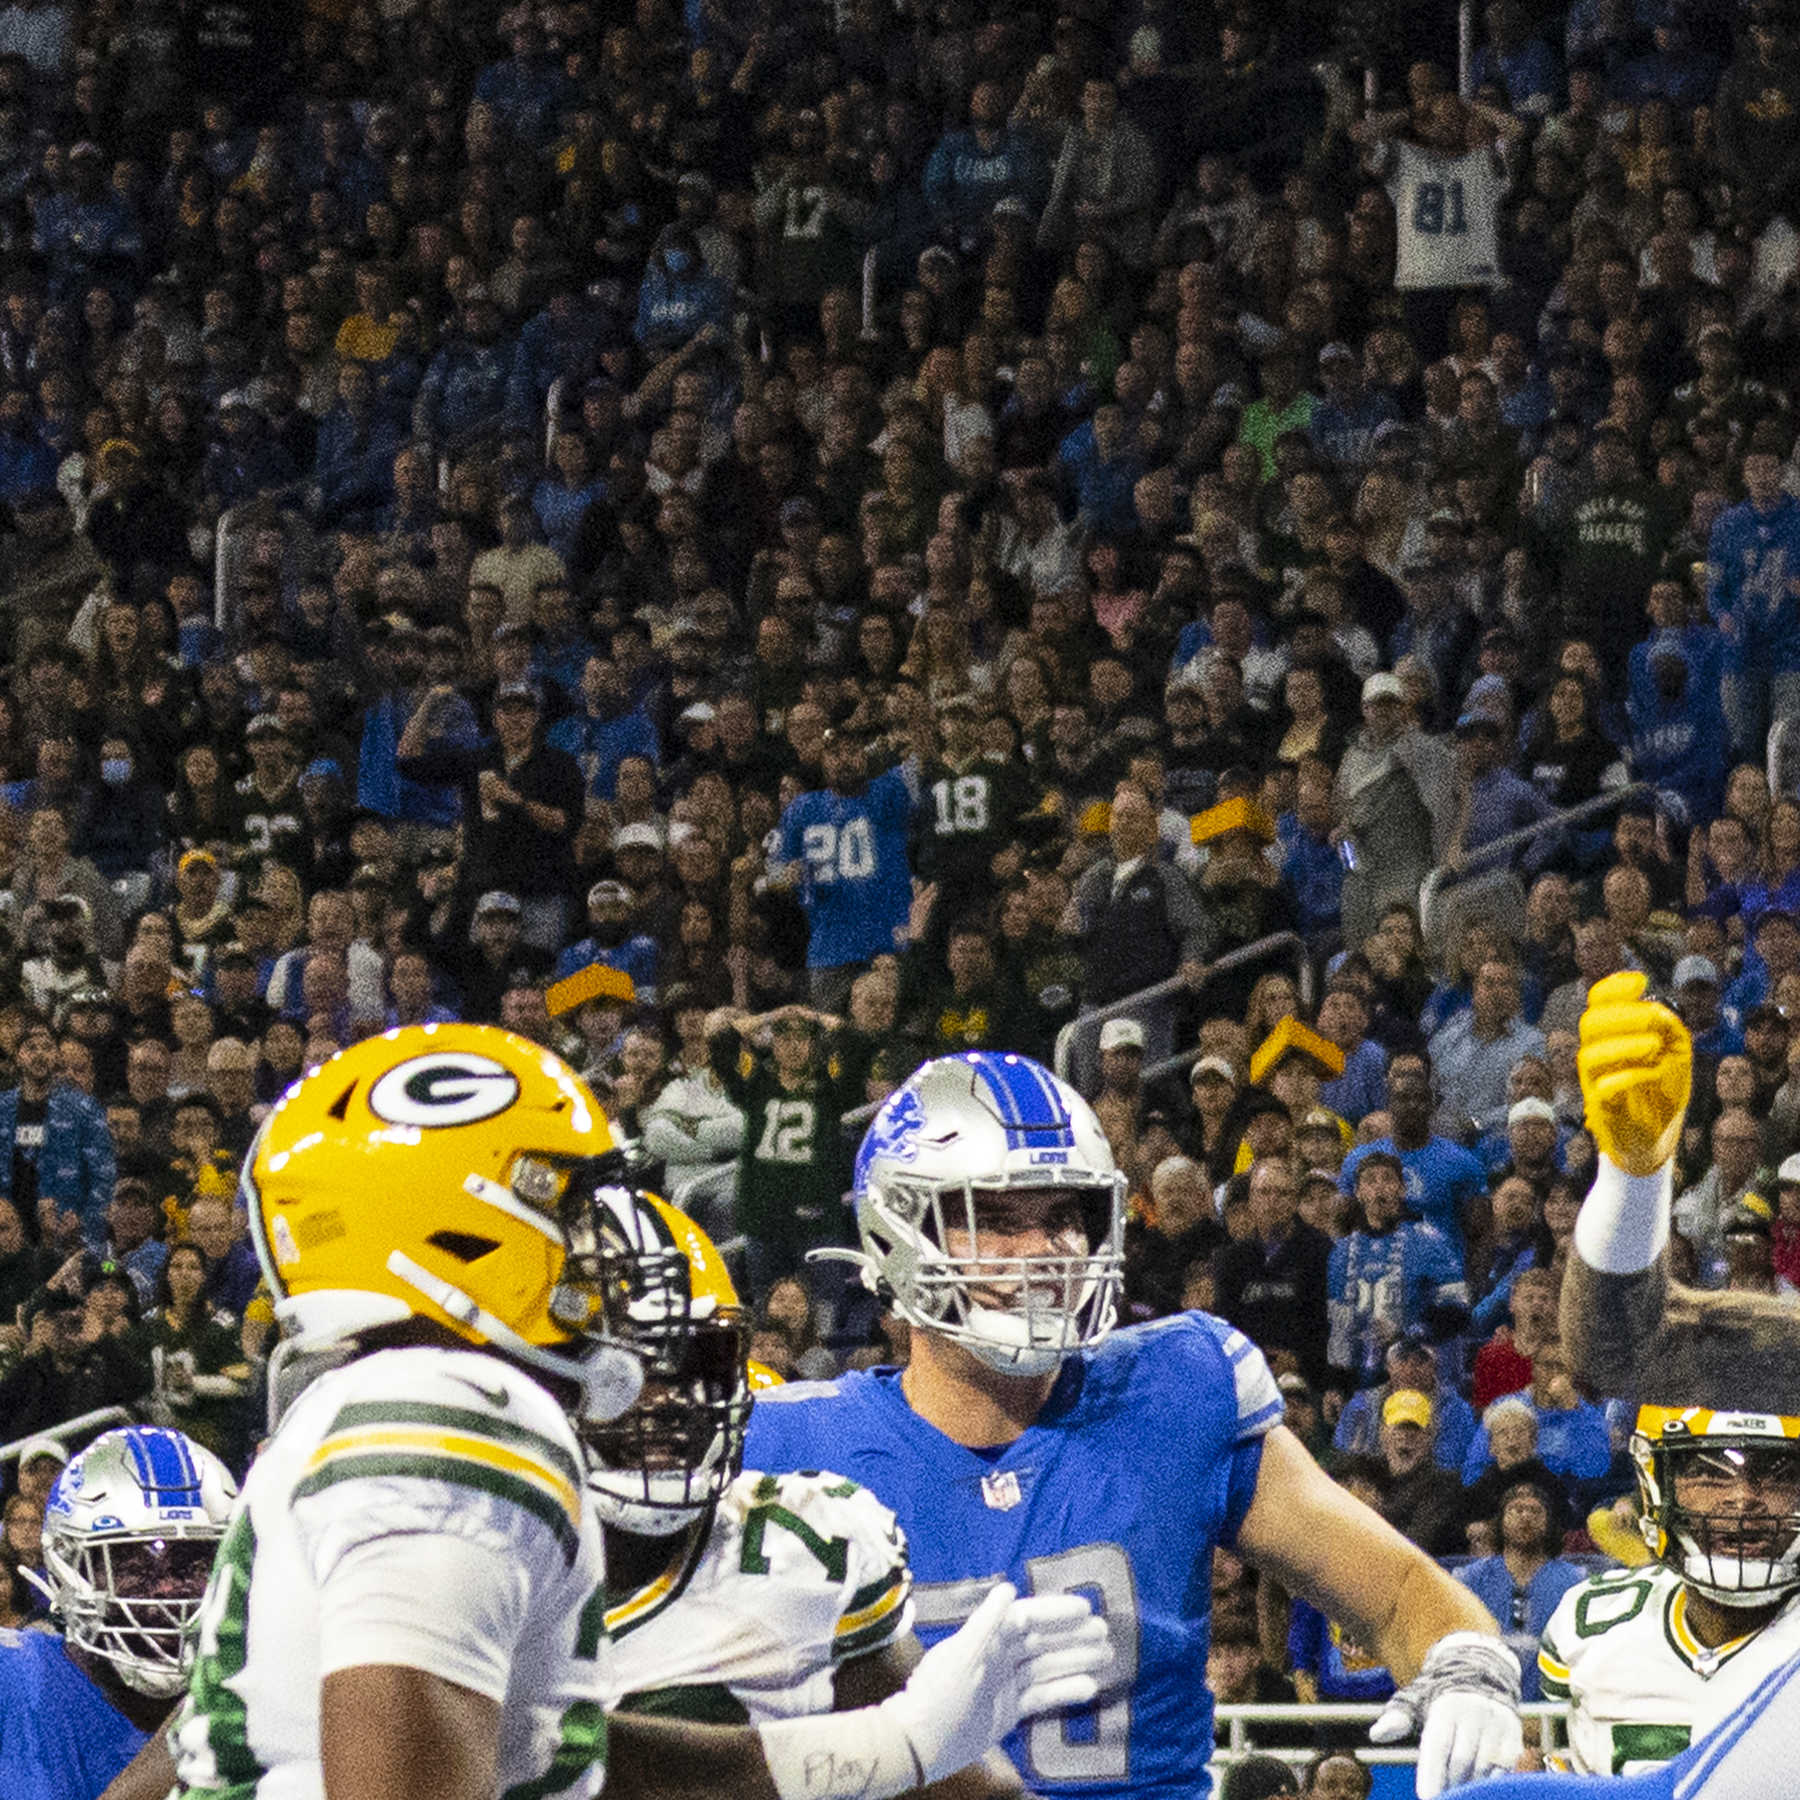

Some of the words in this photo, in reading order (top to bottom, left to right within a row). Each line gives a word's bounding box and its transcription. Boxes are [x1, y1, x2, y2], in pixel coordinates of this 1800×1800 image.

[1414, 180, 1467, 235] 81
[932, 775, 989, 836] 18
[804, 815, 879, 884] 20
[369, 1051, 521, 1129] G
[755, 1098, 818, 1166] 12
[1028, 1151, 1069, 1166] LIONS
[159, 1509, 194, 1522] LIONS
